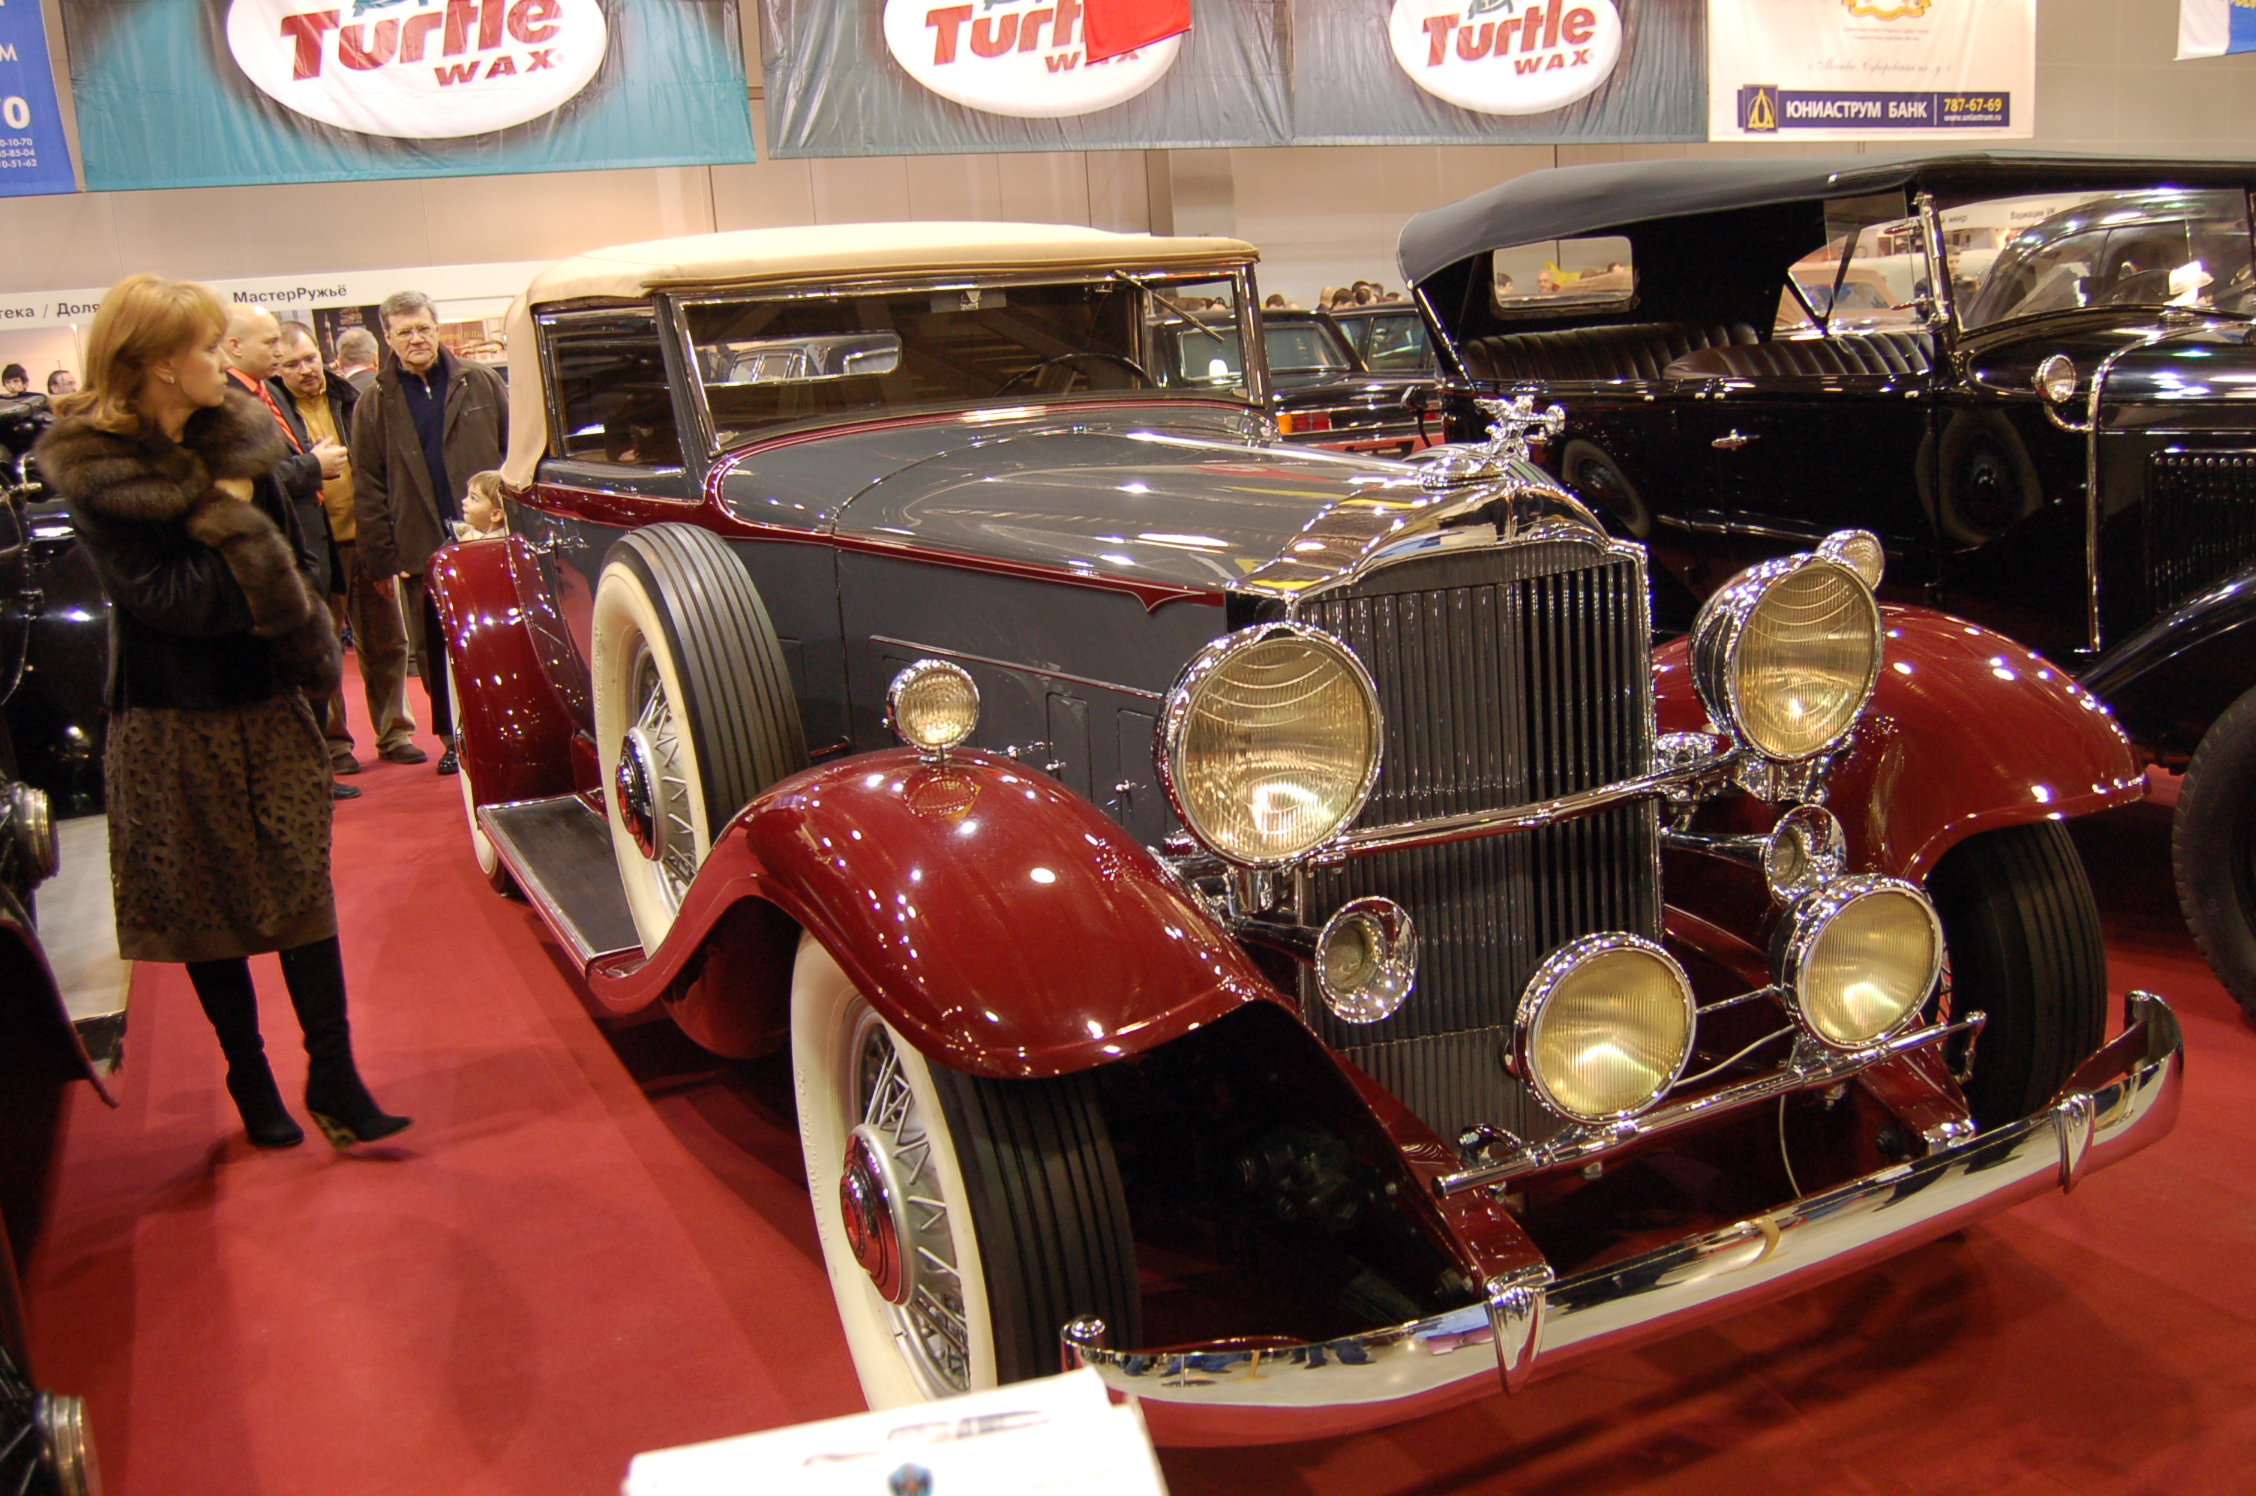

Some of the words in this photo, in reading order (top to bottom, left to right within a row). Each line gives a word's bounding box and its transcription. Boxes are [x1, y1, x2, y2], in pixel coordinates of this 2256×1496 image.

[280, 0, 563, 81] Turtle
[925, 0, 1086, 66] Turt
[1423, 0, 1597, 67] Turtle
[433, 48, 556, 87] WAX
[1514, 48, 1590, 75] WAX
[1786, 100, 1882, 119] ЮНИАСТРУМ
[1888, 101, 1928, 119] БАНК
[1943, 98, 2003, 113] 787-67-69
[233, 284, 348, 304] МастерРужьё
